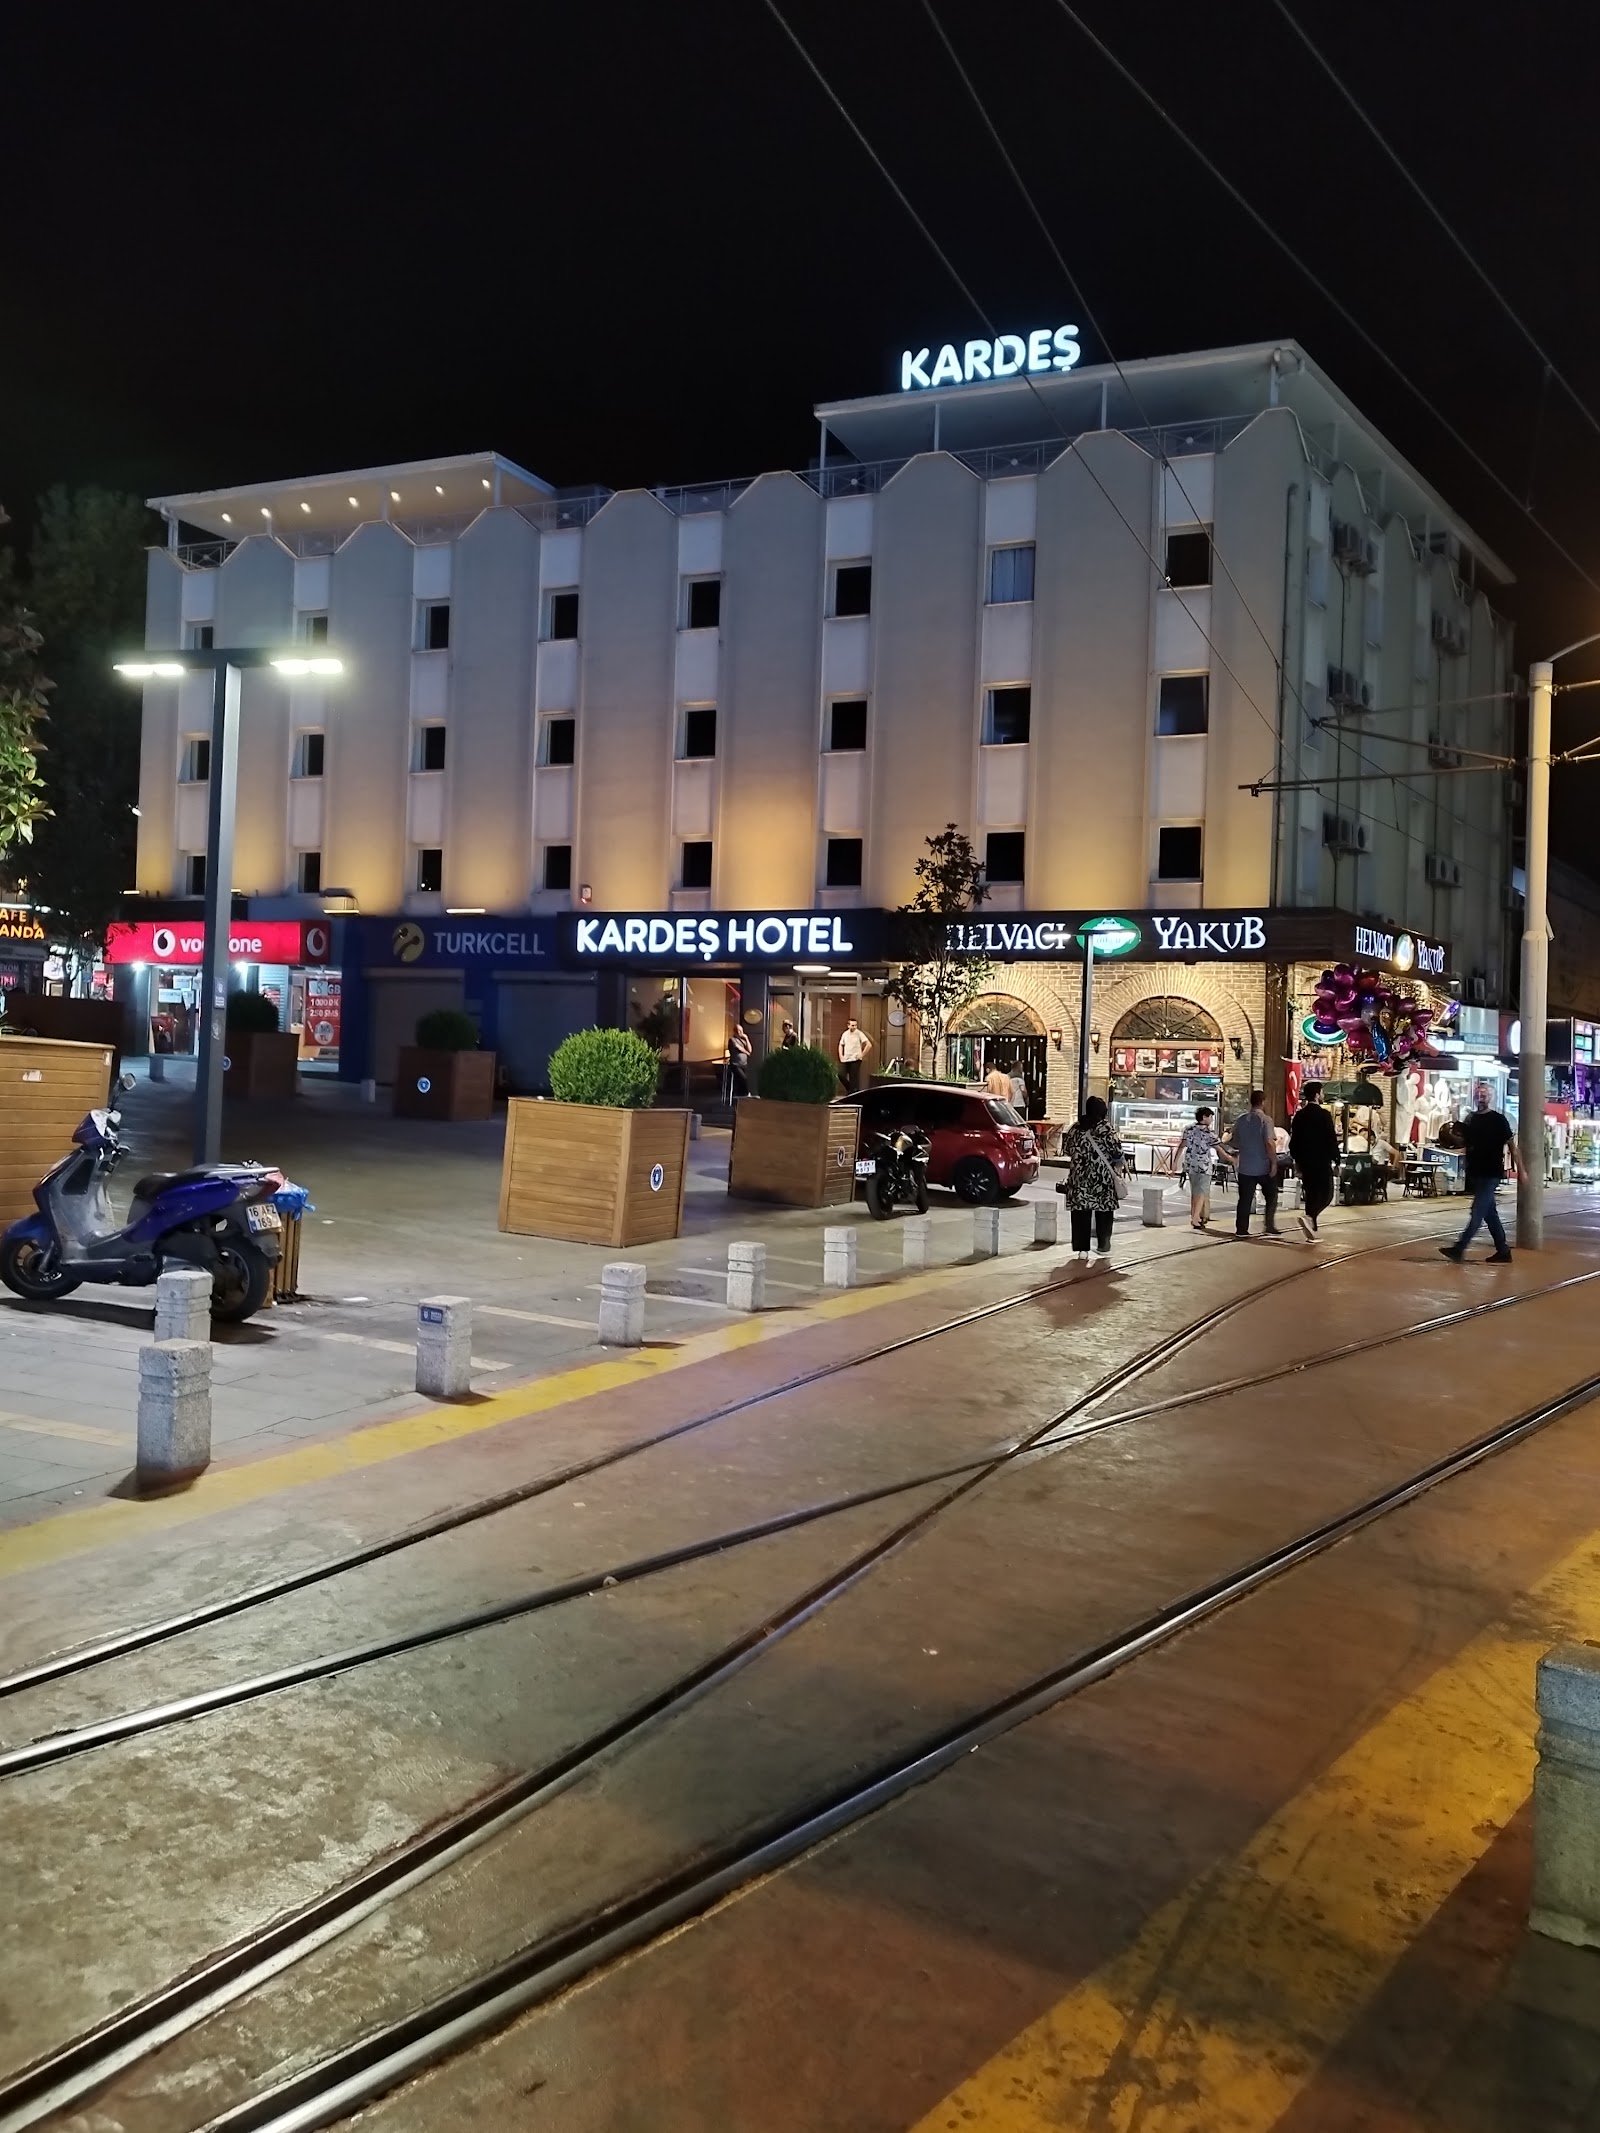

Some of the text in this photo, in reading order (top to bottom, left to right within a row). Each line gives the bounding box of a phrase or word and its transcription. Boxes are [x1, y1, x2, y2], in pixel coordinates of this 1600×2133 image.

[901, 324, 1081, 391] KARDEŞ
[180, 937, 263, 953] voone
[434, 931, 546, 956] TURKCELL
[576, 917, 854, 961] KARDEŞ HOTEL
[1151, 916, 1267, 952] YAKUB
[248, 1207, 259, 1217] 16
